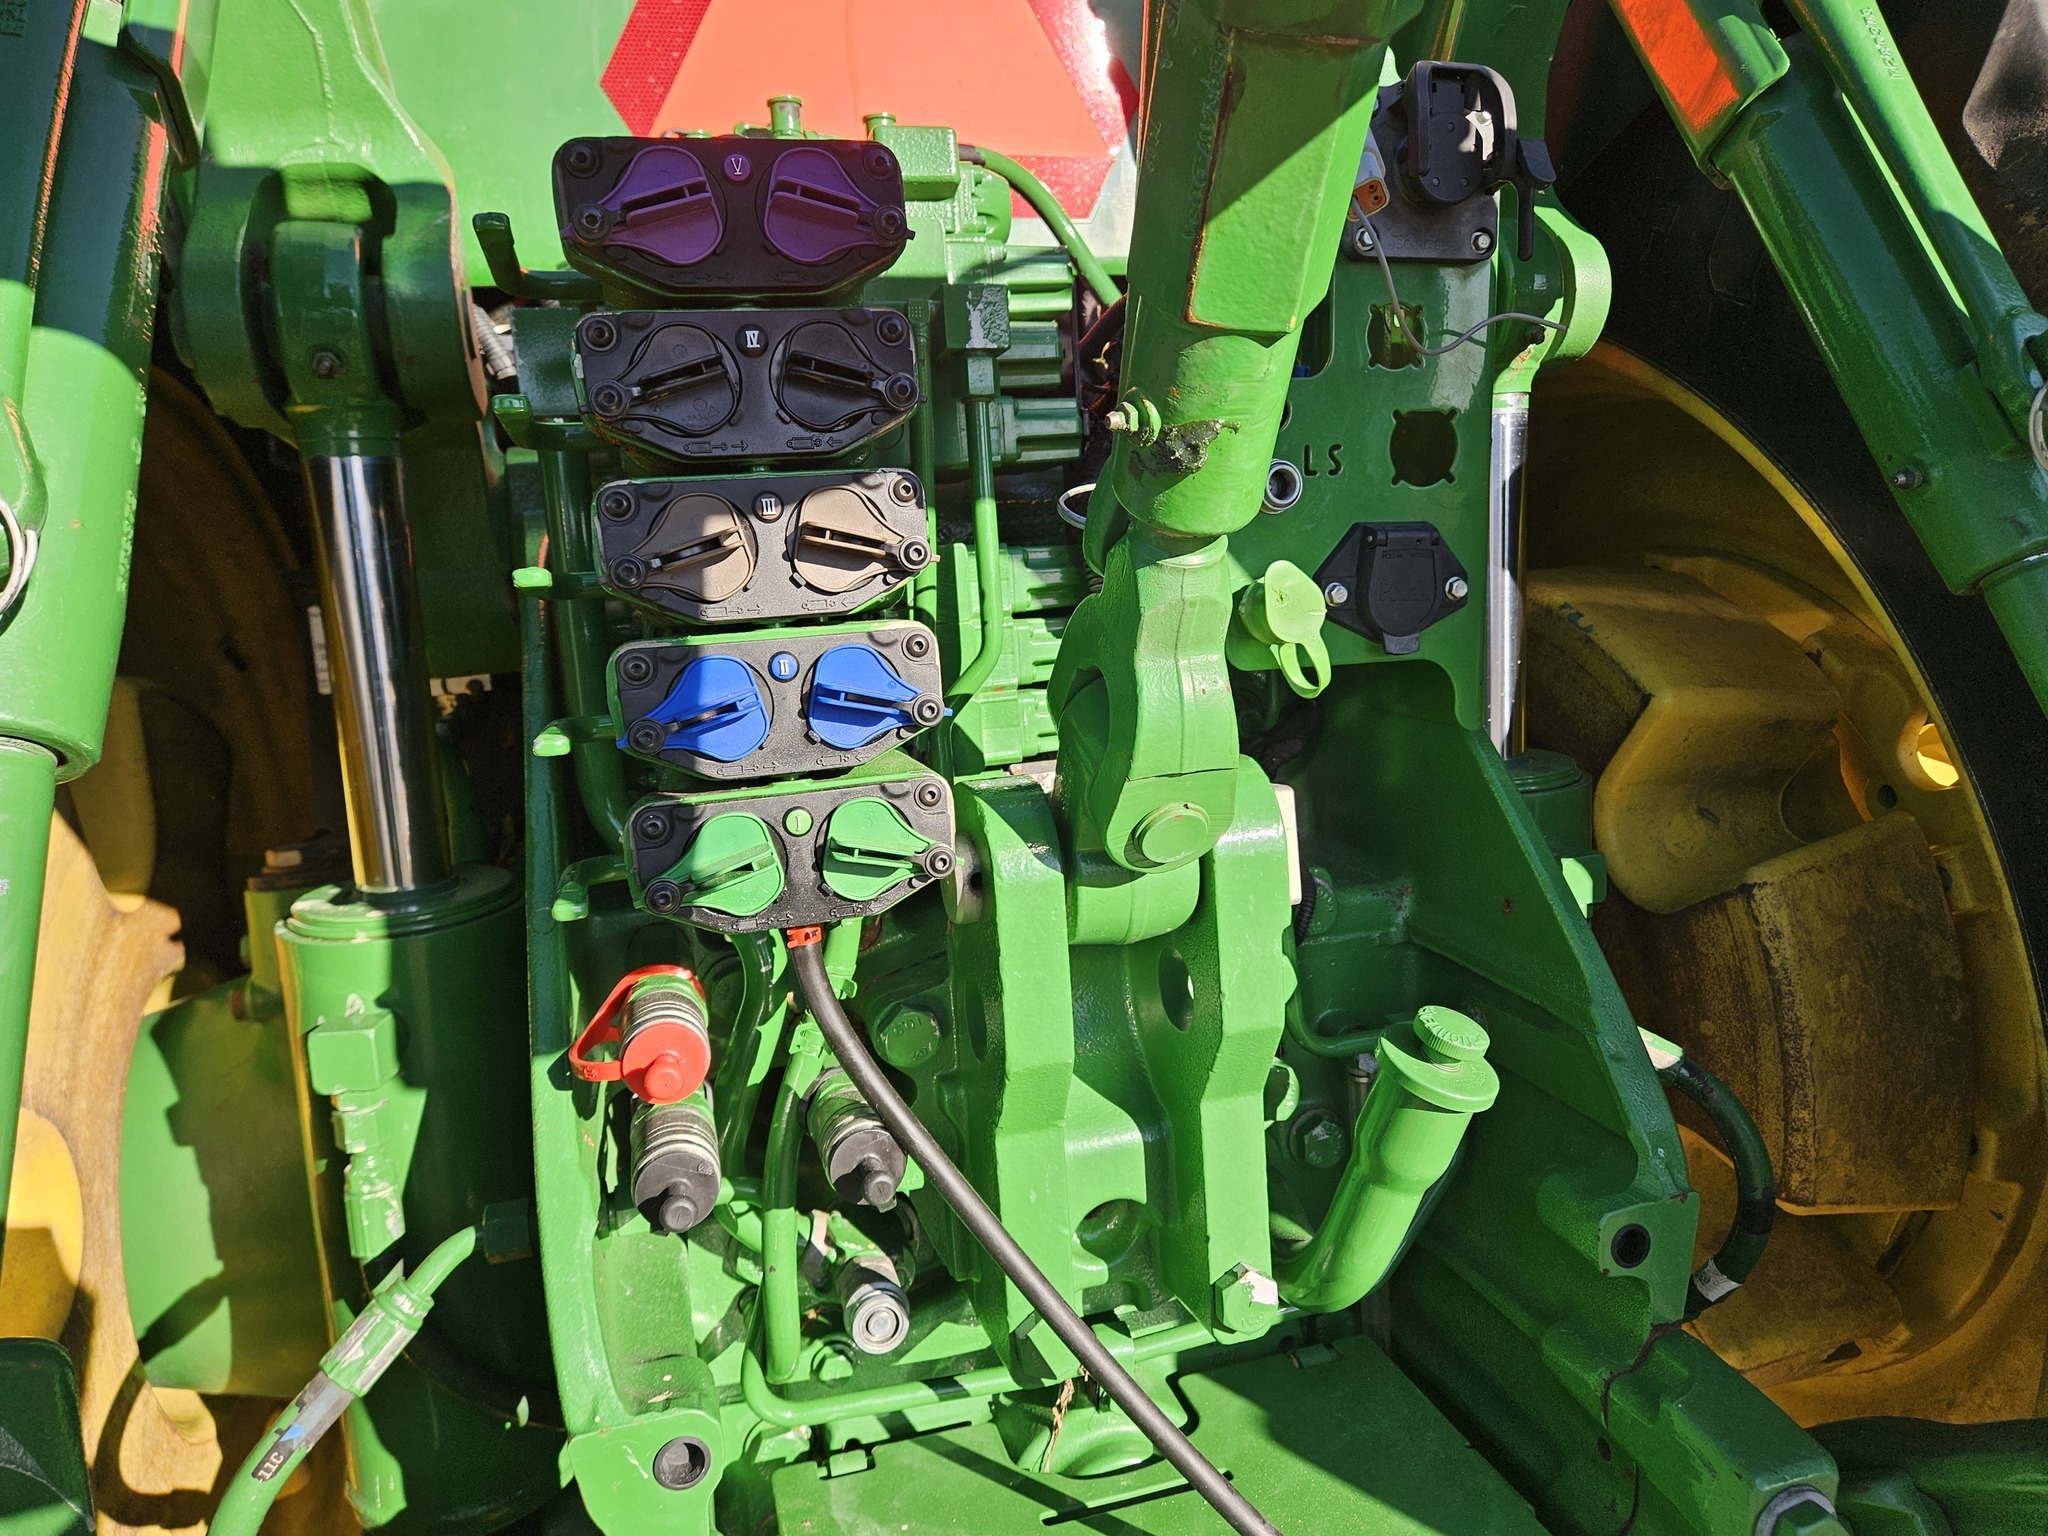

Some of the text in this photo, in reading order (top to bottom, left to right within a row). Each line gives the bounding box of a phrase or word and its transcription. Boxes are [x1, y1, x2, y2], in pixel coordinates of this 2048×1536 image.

[730, 157, 742, 175] V
[744, 330, 760, 348] IV
[1302, 444, 1344, 477] LS
[760, 497, 776, 516] III
[776, 659, 788, 677] II
[794, 815, 802, 831] I
